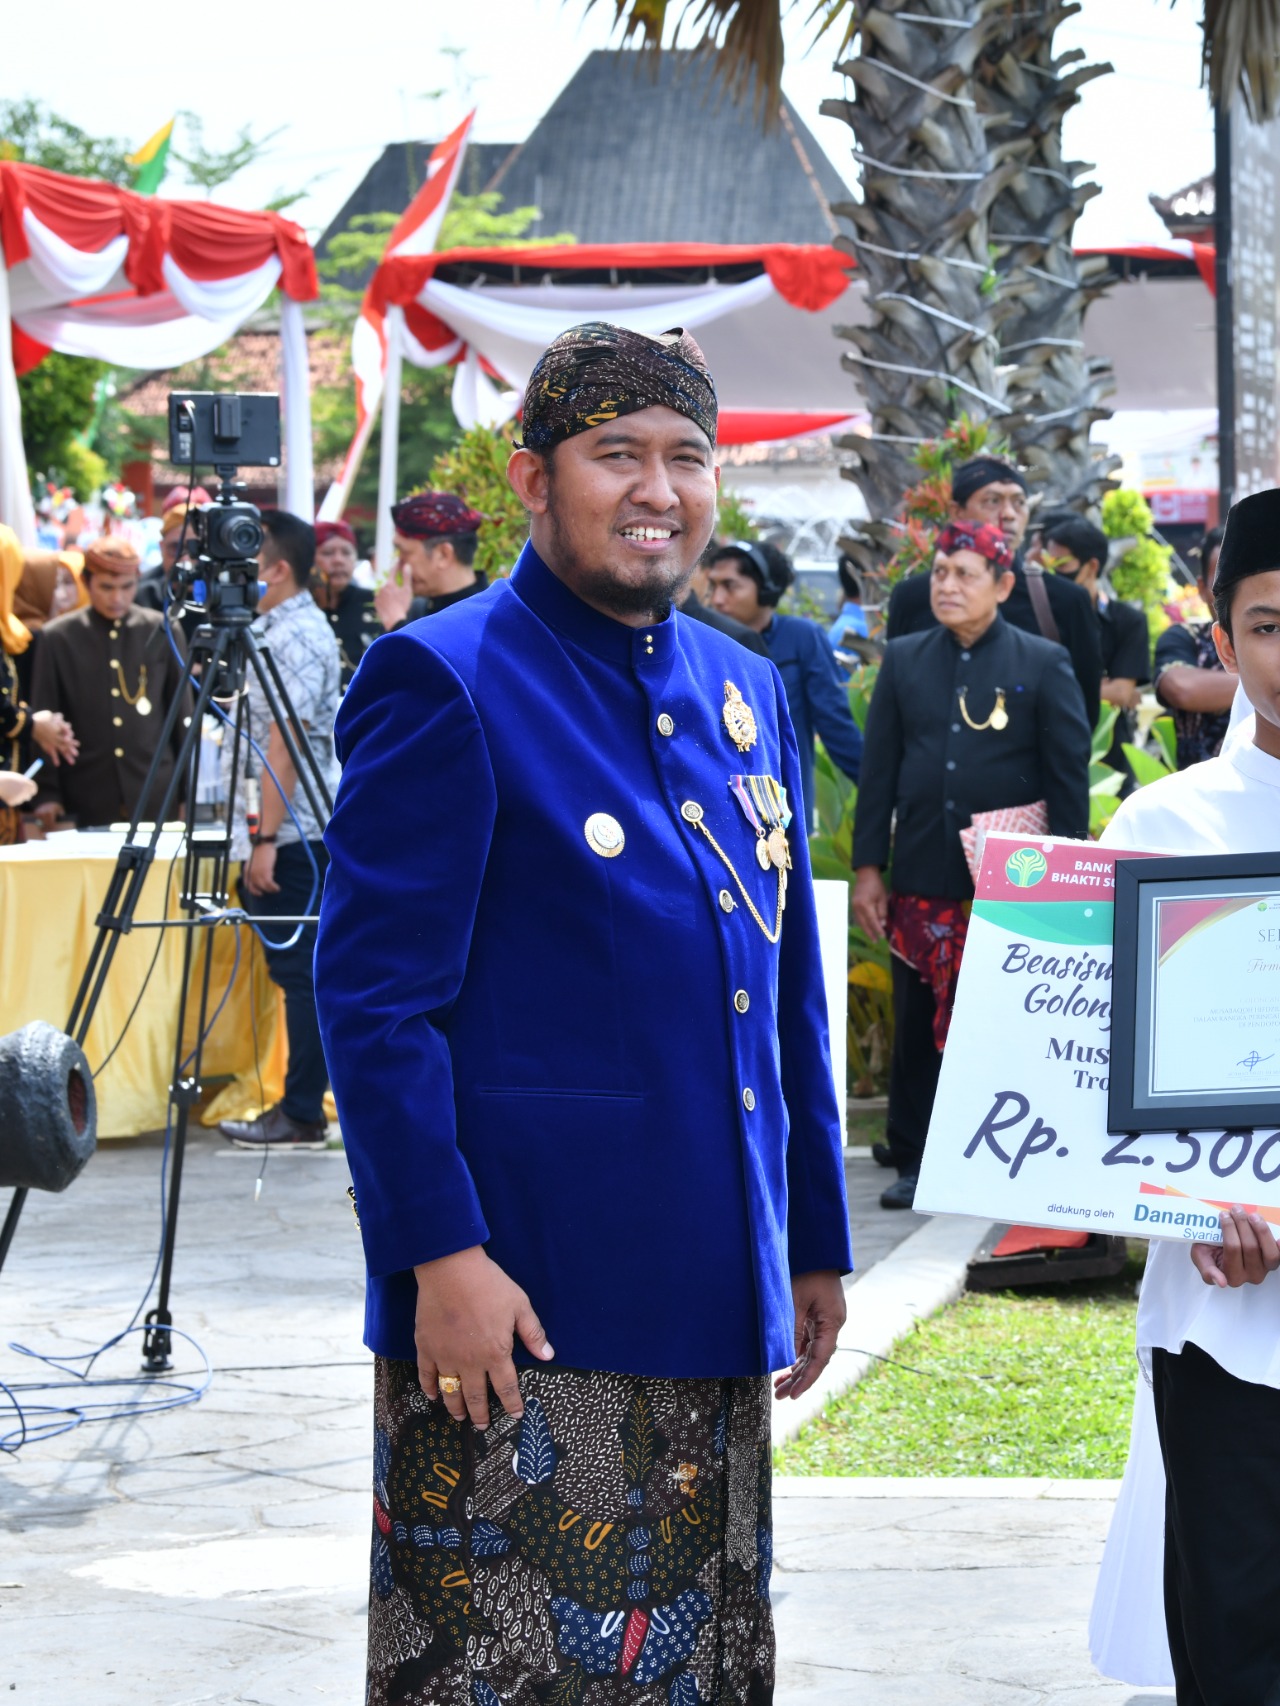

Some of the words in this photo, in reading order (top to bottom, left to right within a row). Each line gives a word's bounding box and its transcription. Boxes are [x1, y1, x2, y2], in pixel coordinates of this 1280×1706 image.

[1074, 861, 1113, 874] BANK
[1051, 872, 1101, 887] BHAKTI
[1044, 1037, 1110, 1065] Mus
[963, 1090, 1069, 1180] Rp.
[1047, 1204, 1091, 1219] didukung
[1093, 1208, 1115, 1220] oleh
[1133, 1203, 1223, 1230] Danamo
